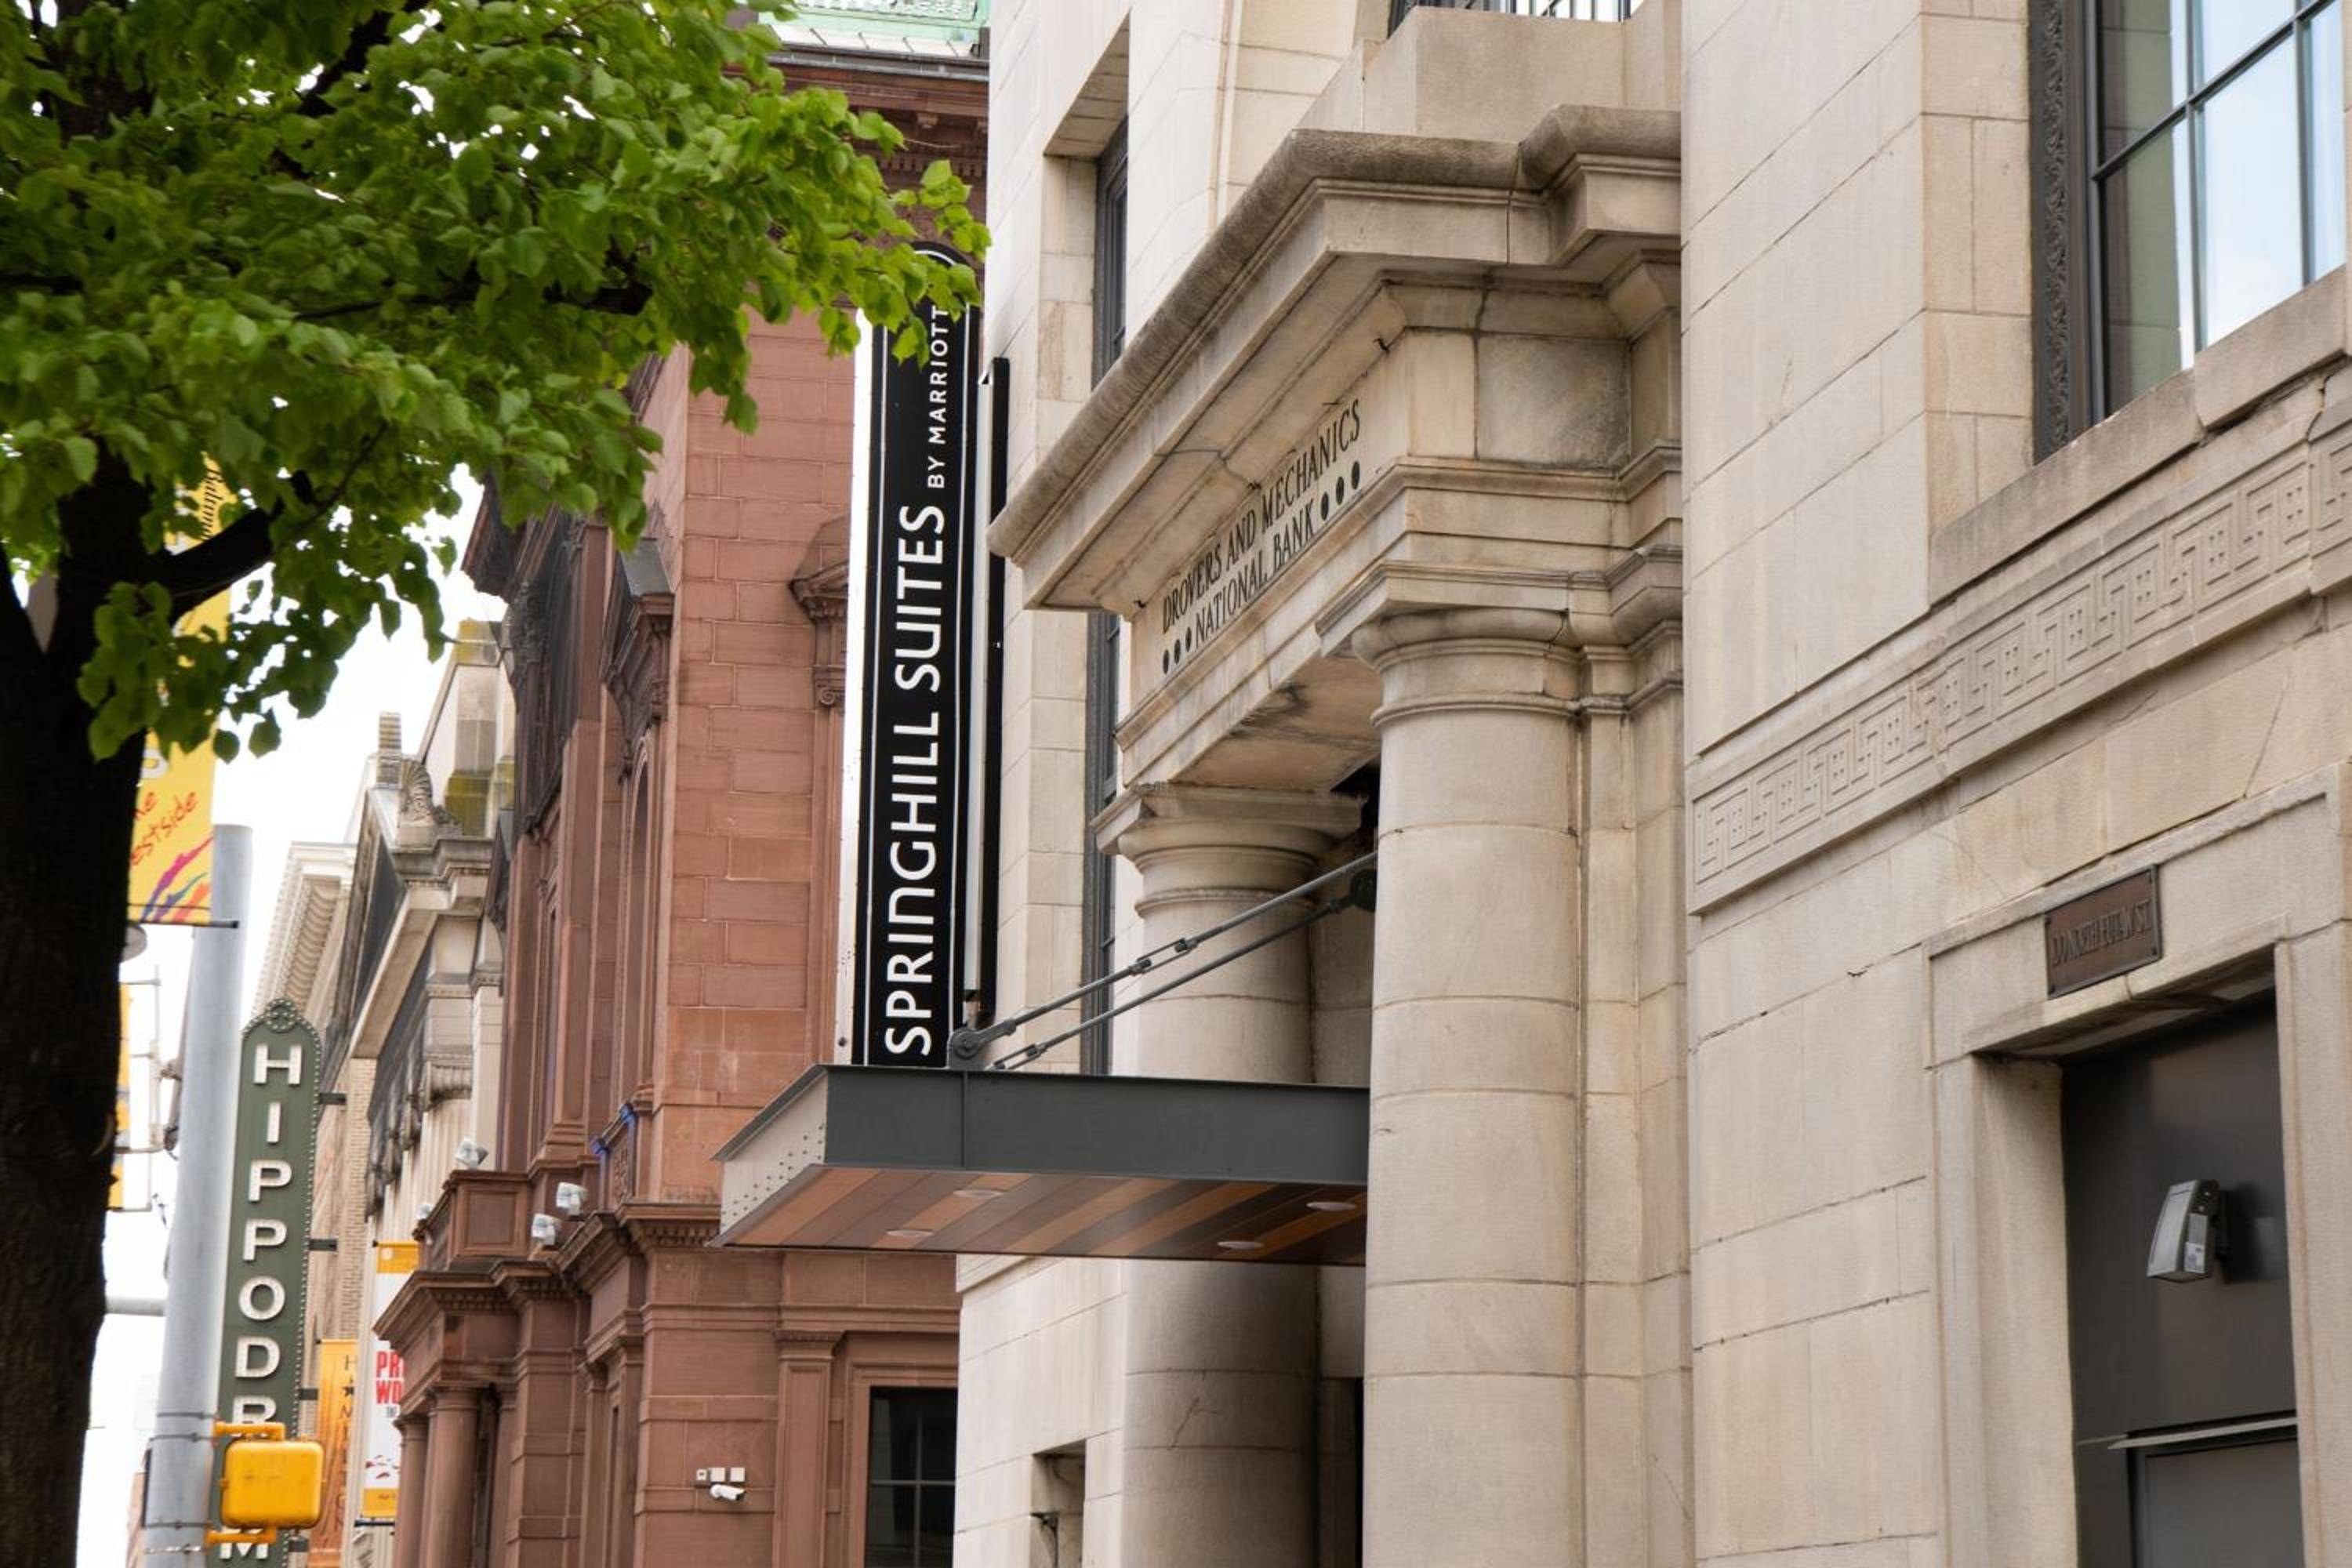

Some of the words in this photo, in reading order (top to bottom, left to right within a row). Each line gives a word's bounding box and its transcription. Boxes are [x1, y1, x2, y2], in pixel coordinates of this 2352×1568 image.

[928, 305, 949, 445] MARRIOTT
[927, 456, 946, 489] BY
[1163, 544, 1222, 633] DROVERS
[1226, 510, 1255, 571] AND
[1261, 398, 1361, 535] MECHANICS
[895, 505, 944, 693] SUITES
[1195, 550, 1268, 649] NATIONAL
[1273, 499, 1315, 575] BANK
[885, 710, 939, 1057] SPRINGHILL
[219, 1043, 303, 1559] HIPPODRM
